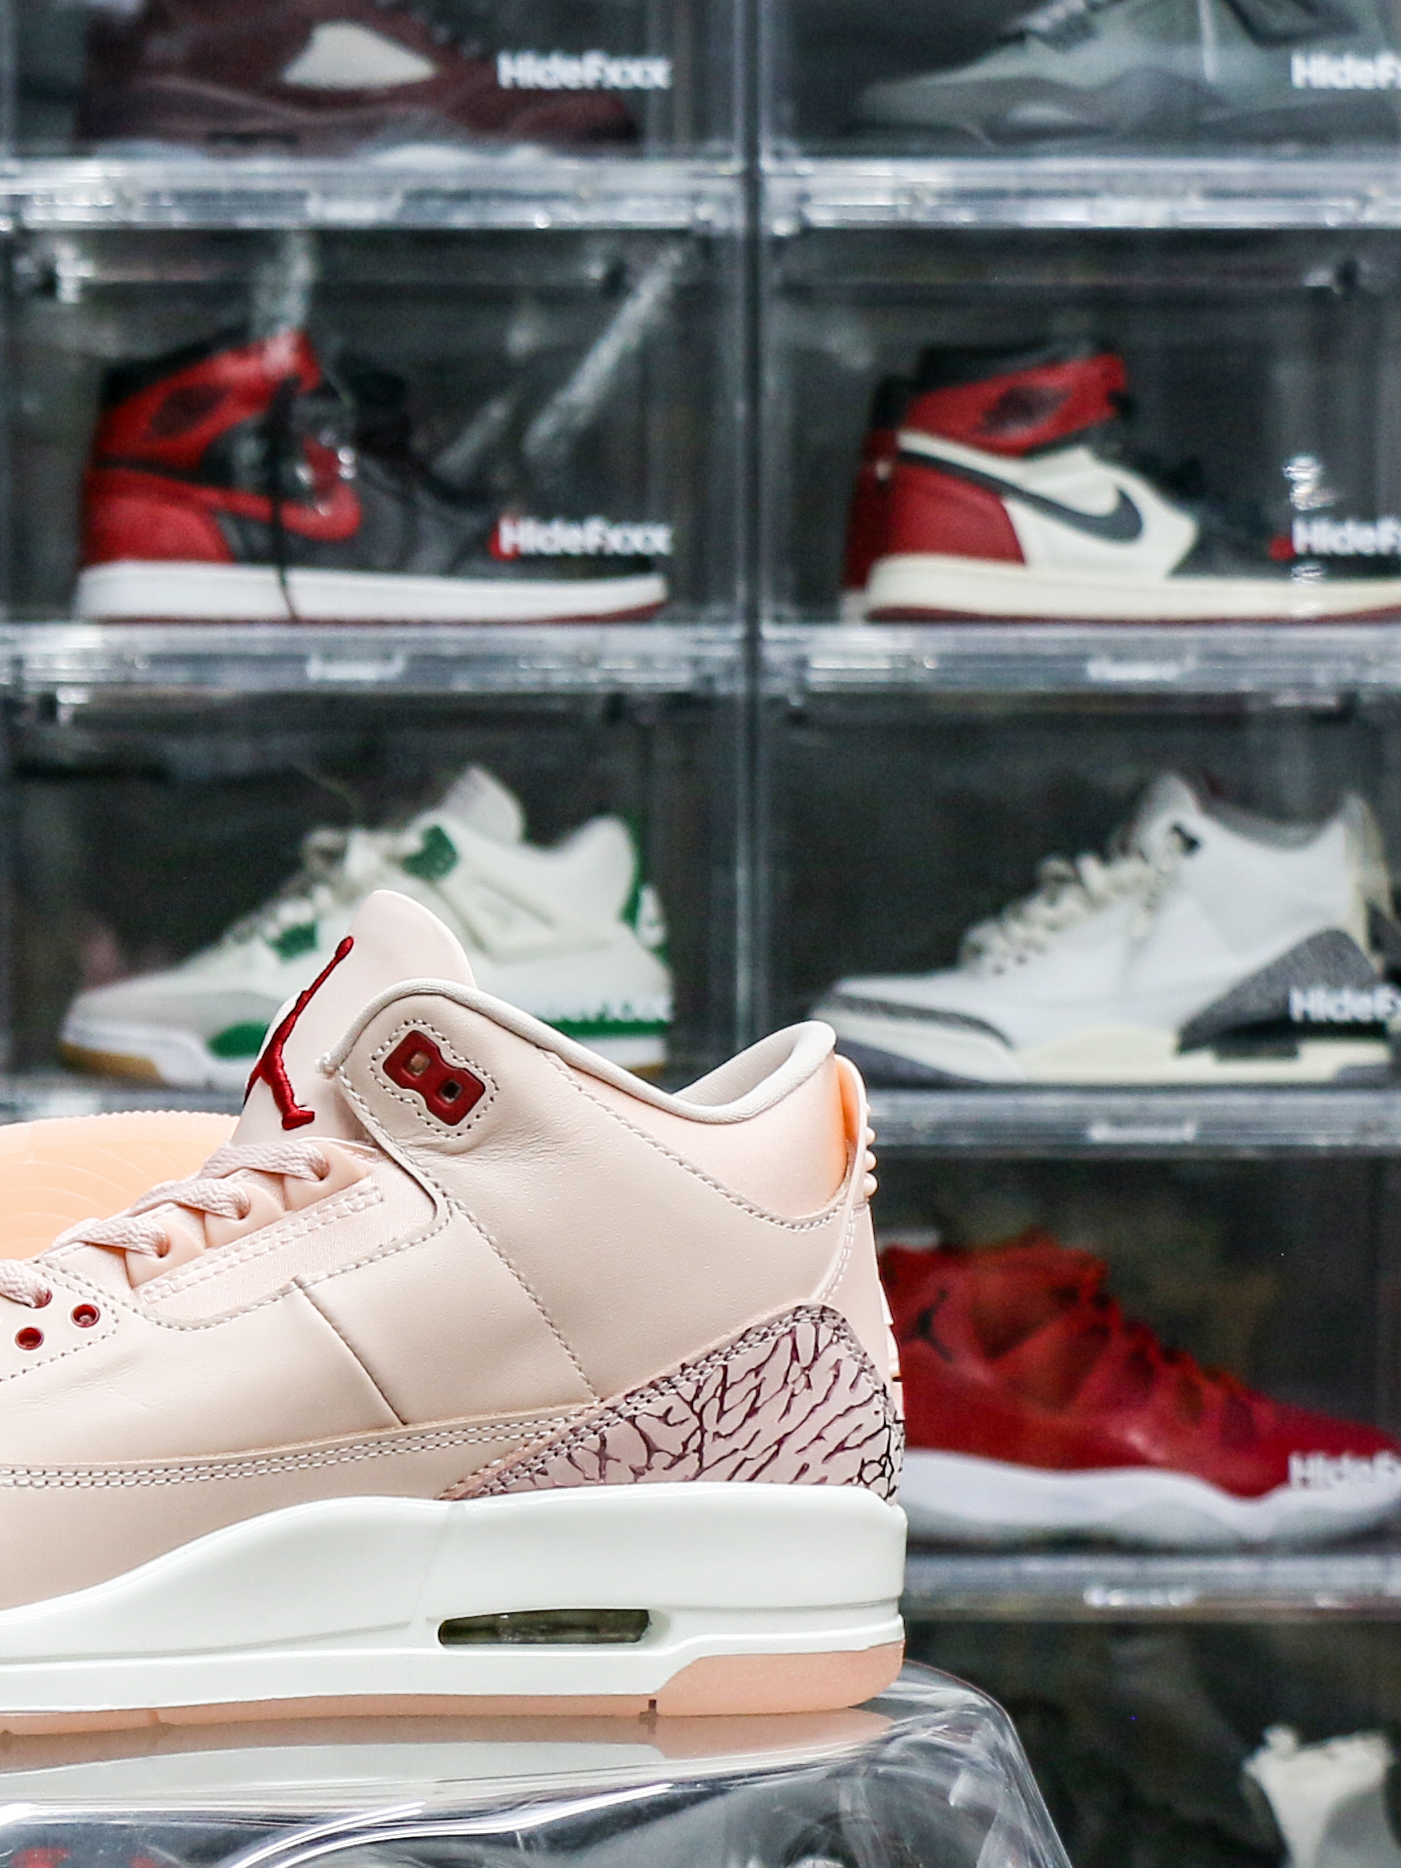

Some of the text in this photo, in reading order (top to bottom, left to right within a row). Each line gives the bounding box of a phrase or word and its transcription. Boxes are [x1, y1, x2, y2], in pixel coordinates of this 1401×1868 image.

[497, 50, 672, 89] HideFxxx
[1291, 51, 1401, 89] HideF
[498, 516, 673, 556] HideFxxx
[1292, 516, 1401, 556] HideF
